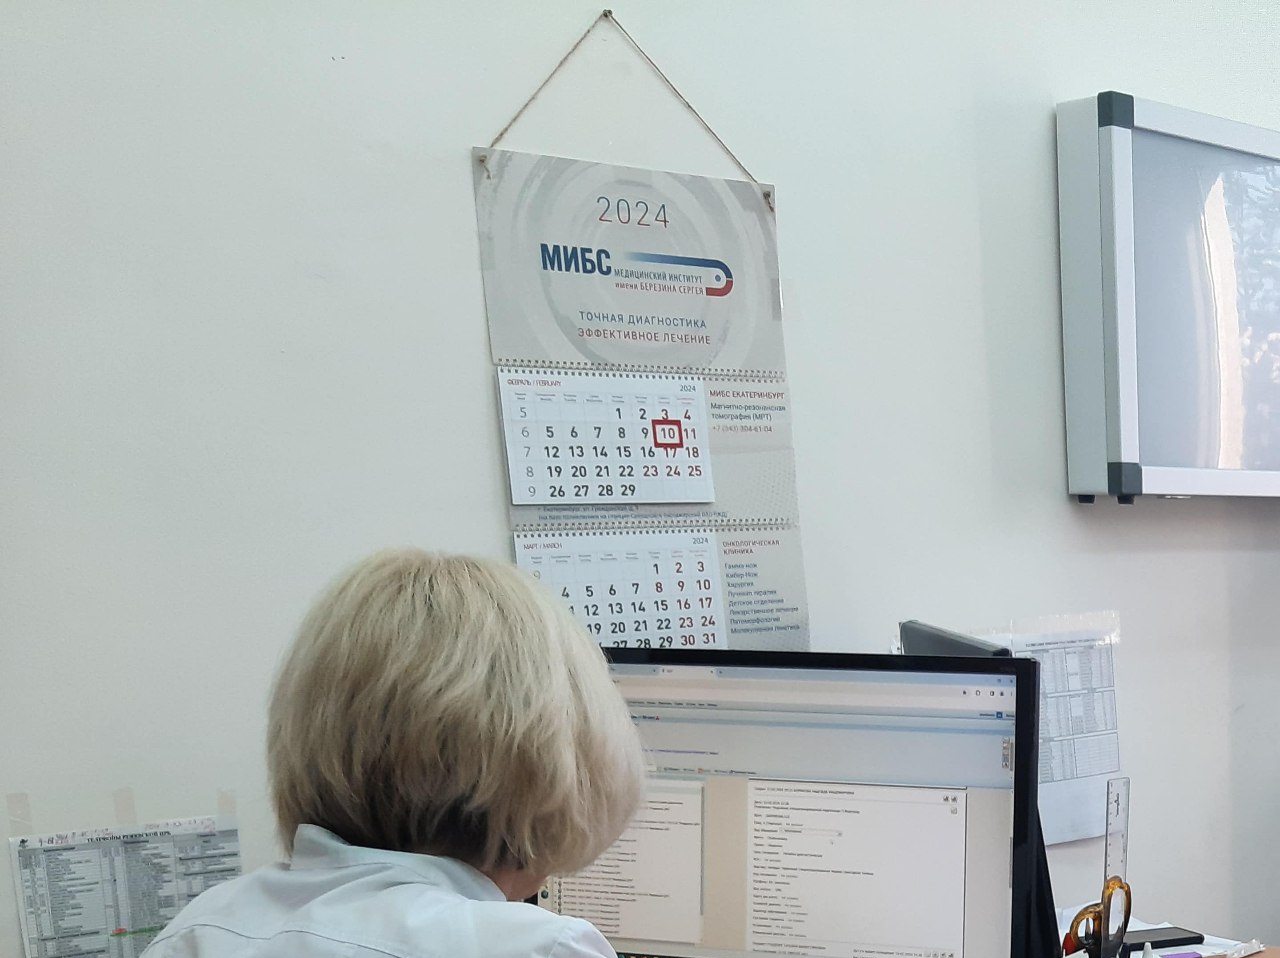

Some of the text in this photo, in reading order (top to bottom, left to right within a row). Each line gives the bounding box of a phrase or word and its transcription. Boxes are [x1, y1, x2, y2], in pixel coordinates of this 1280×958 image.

[597, 196, 670, 229] 2024
[540, 243, 612, 276] МИБС
[614, 268, 702, 284] МЕДИЦИНСКИЙ ИНСТИТУТ
[640, 282, 677, 293] БЕРЕЗИНА
[679, 285, 704, 295] СЕРГЕЯ
[579, 311, 707, 329] ТОЧНАЯ ДИАГНОСТИКА
[577, 327, 711, 345] ЭФФЕКТИВНОЕ ЛЕЧЕНИЕ
[709, 390, 731, 398] МИБС
[520, 407, 691, 420] 5 1 2 3 4
[521, 426, 696, 440] 6 5 6 7 8 9 10 11
[524, 446, 700, 458] 7 12 13 14 15 16 17 18
[526, 465, 702, 478] 8 19 20 21 22 23 24 25
[528, 484, 636, 498] 9 26 27 28 29
[653, 564, 659, 575] 1
[675, 562, 683, 573] 2
[697, 561, 705, 573] 3
[561, 579, 711, 598] 4 5 6 7 8 9 10
[584, 604, 599, 616] 12
[608, 603, 624, 615] 13
[631, 601, 646, 613] 14
[654, 600, 669, 611] 15
[676, 599, 691, 610] 16
[698, 597, 713, 609] 17
[587, 615, 716, 635] 19 20 21 22 23 24
[636, 639, 651, 648] 28
[658, 636, 673, 649] 29
[680, 635, 695, 646] 30
[702, 633, 716, 644] 31
